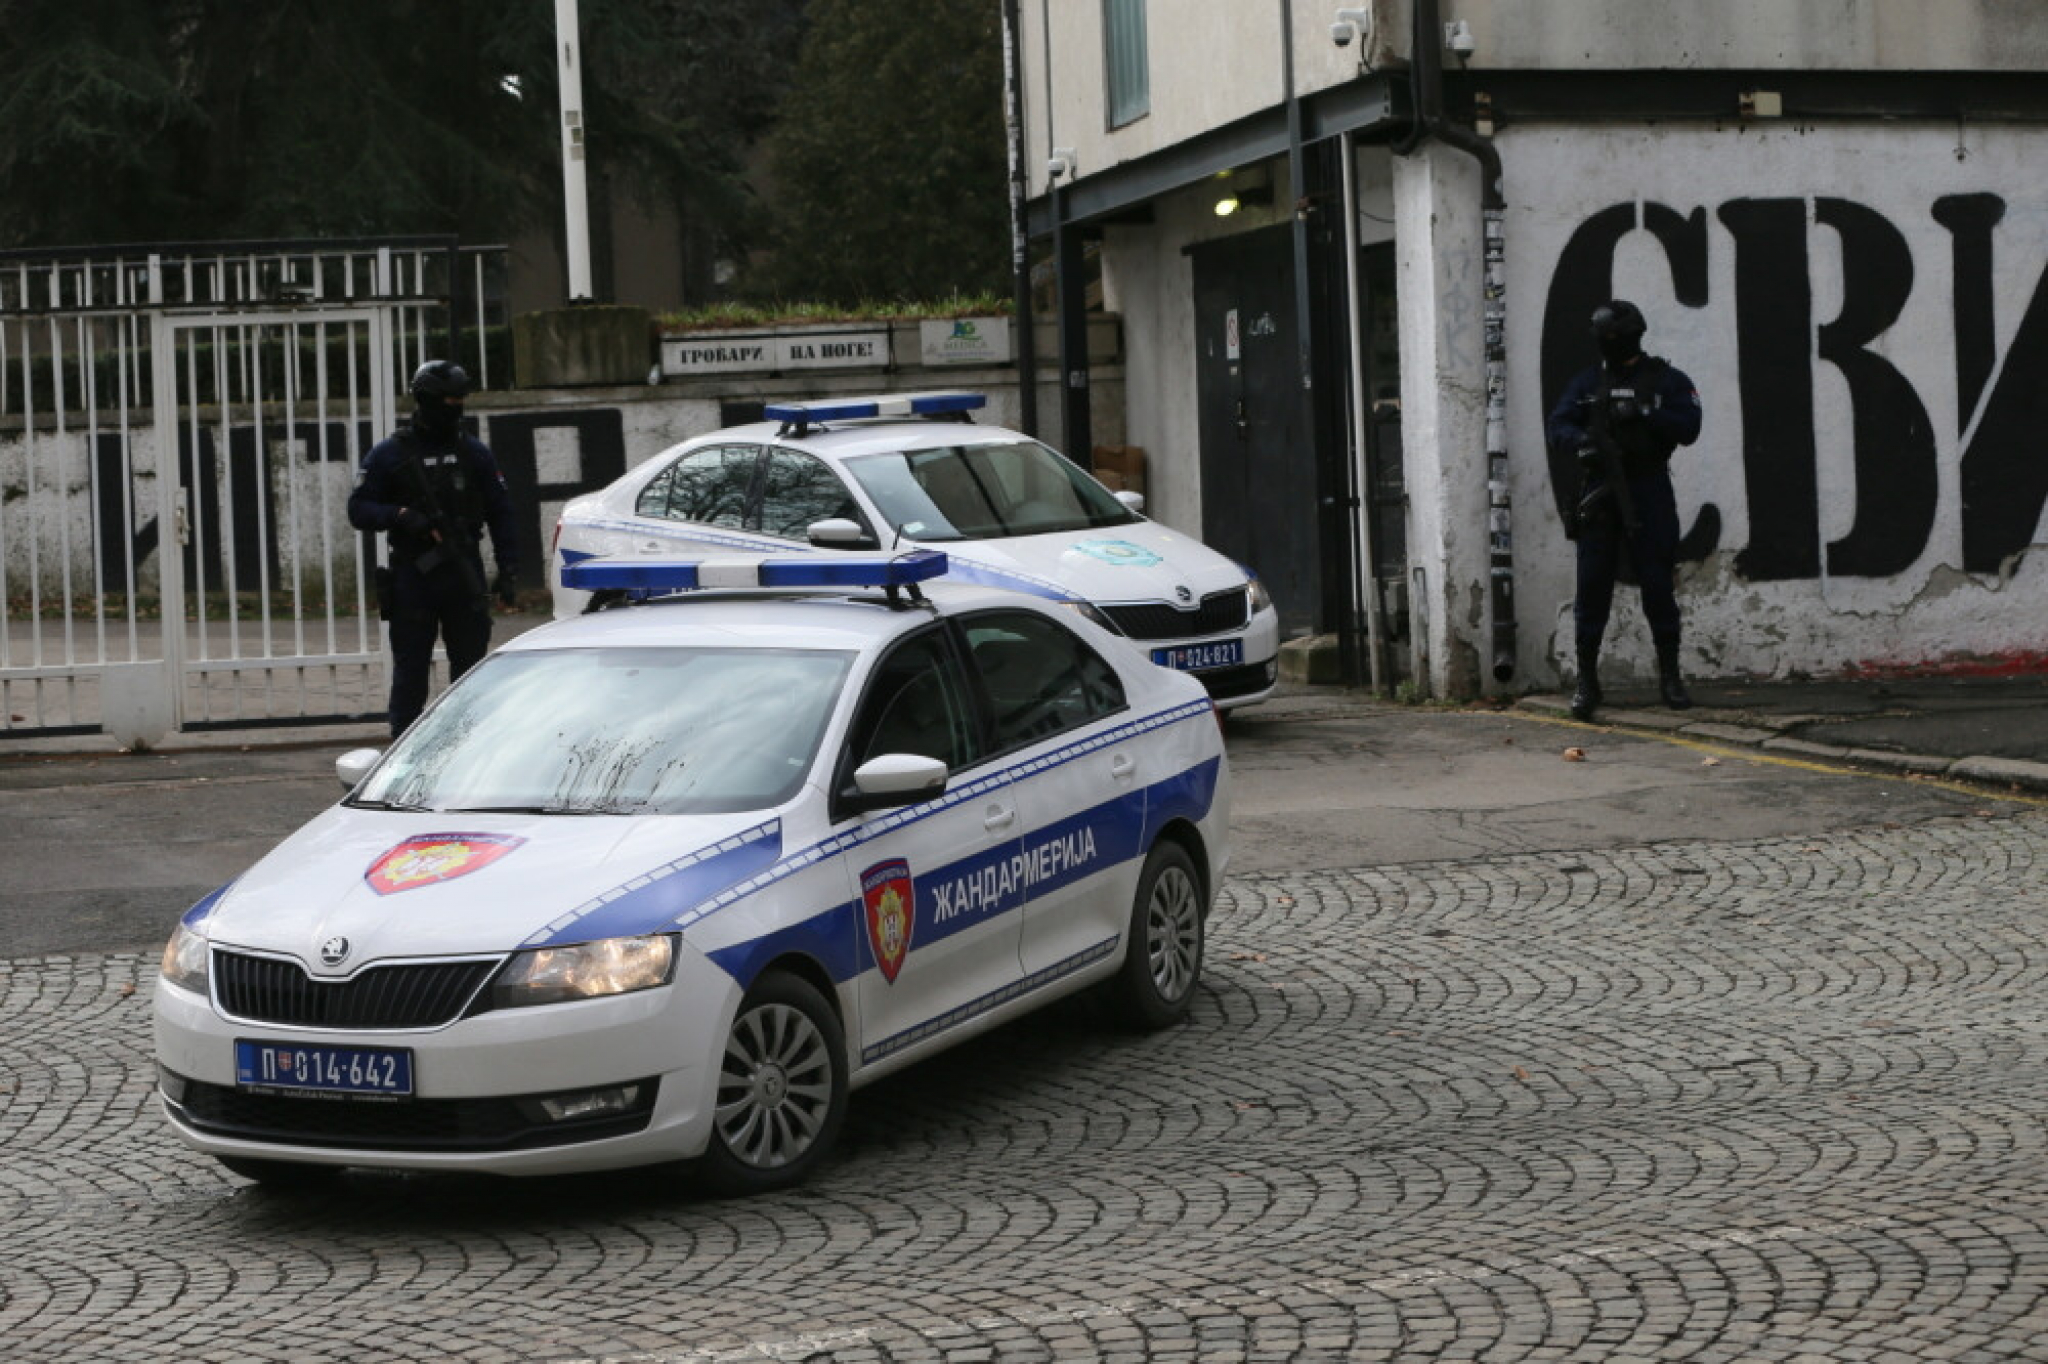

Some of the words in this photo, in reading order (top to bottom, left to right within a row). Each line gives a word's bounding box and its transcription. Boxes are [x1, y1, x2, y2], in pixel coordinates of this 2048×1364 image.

[681, 345, 765, 364] ГРОБАРИ
[790, 345, 816, 360] НА
[821, 341, 873, 359] НОГЕ!
[932, 825, 1097, 924] ЖАНДАРМЕРИЈА
